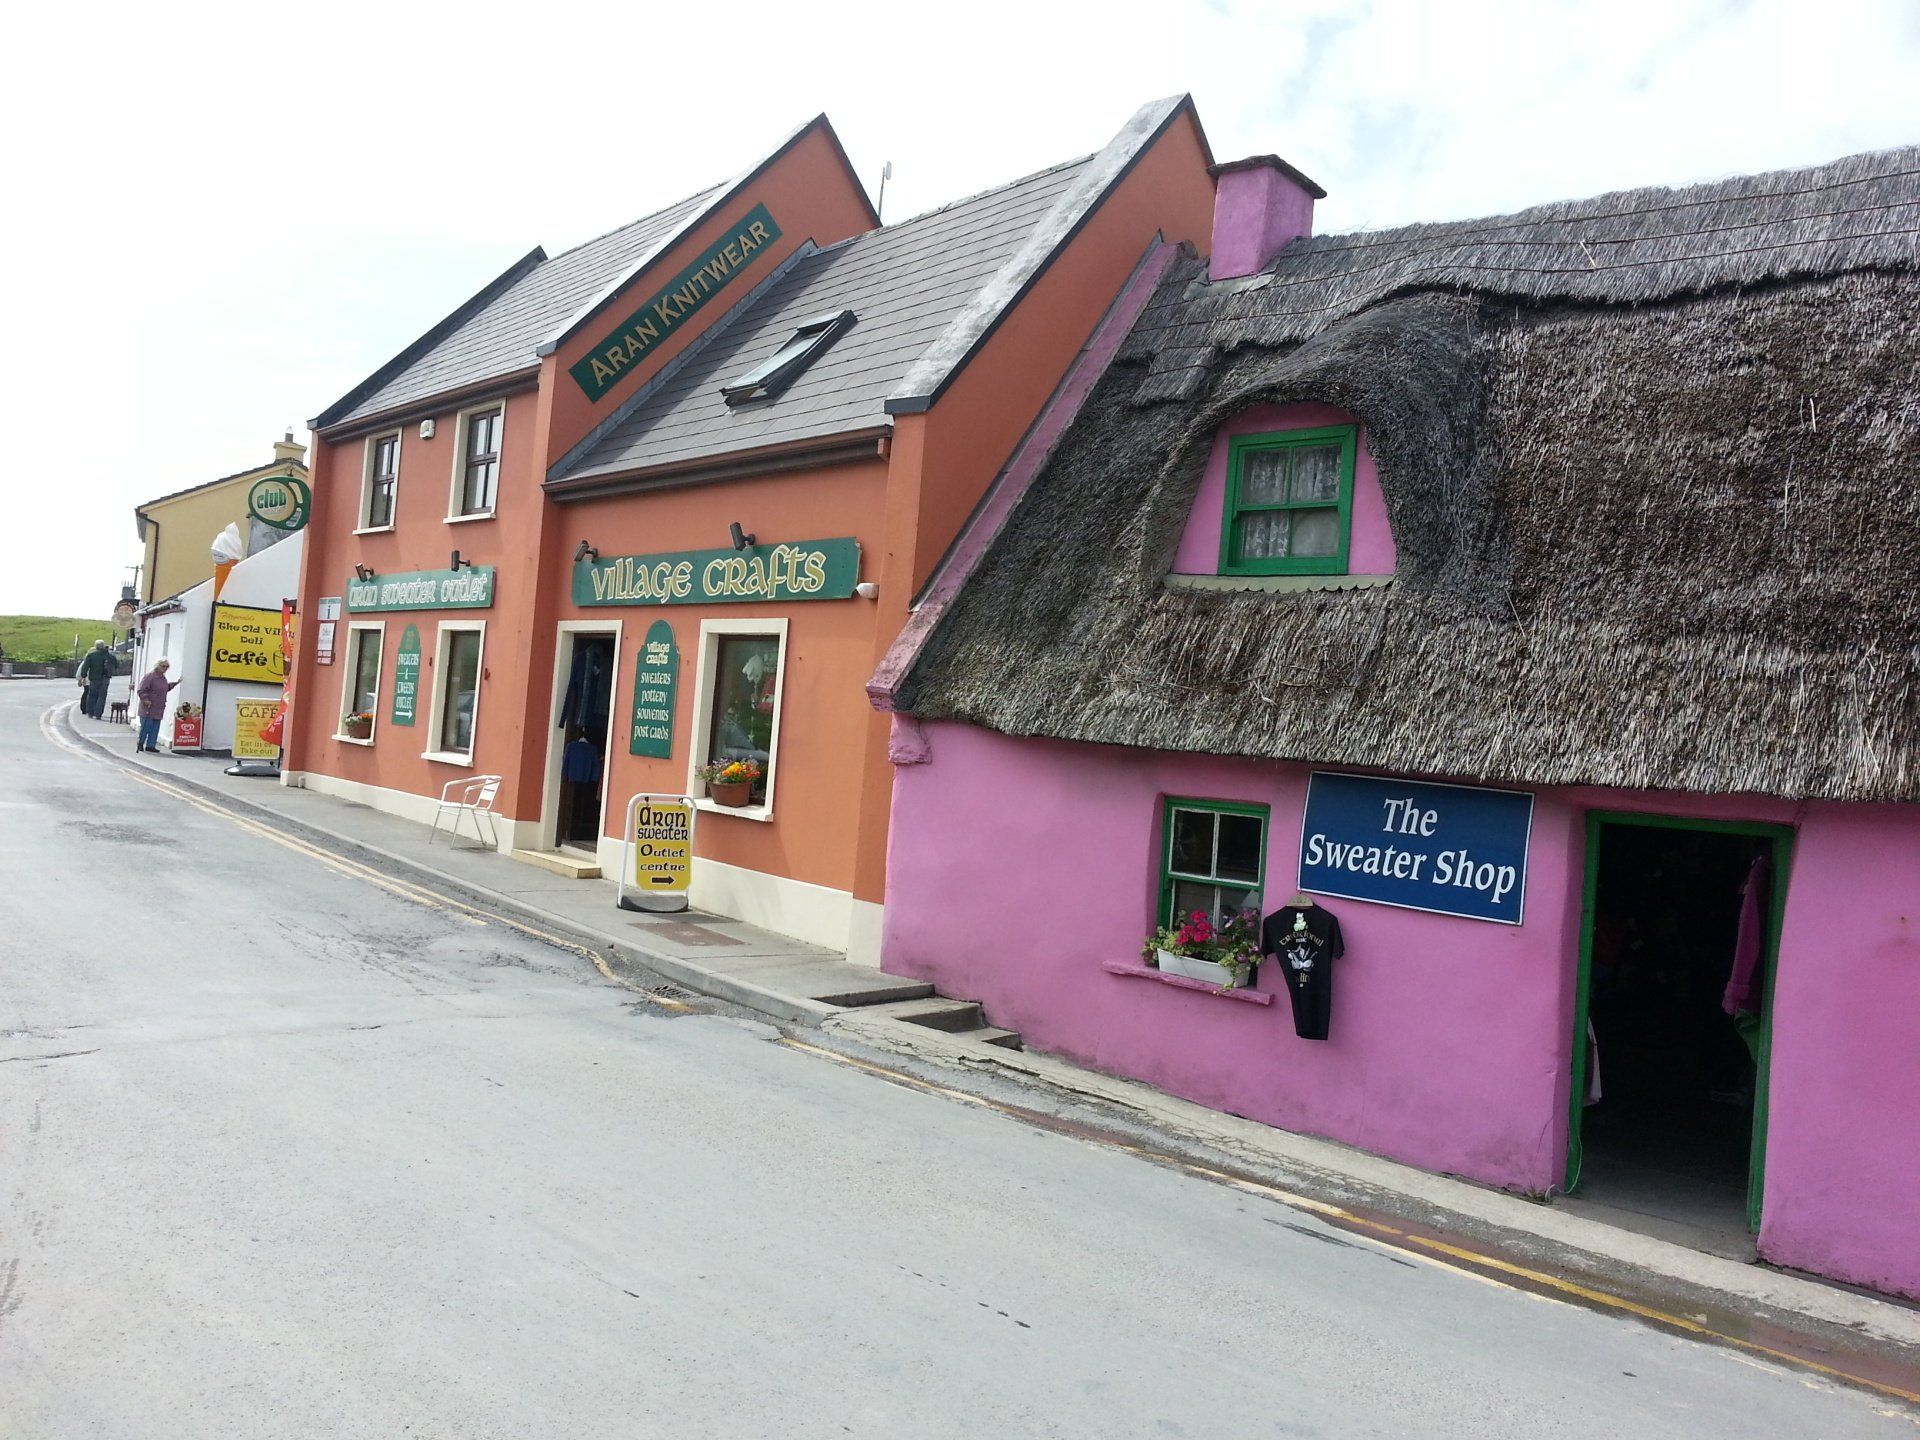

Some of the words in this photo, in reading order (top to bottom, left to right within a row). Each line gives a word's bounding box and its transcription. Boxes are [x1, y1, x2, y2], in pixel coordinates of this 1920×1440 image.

[590, 317, 660, 388] ARAN
[653, 220, 770, 328] KNITWEAR
[256, 488, 287, 509] club
[218, 621, 240, 632] The
[241, 625, 261, 633] Old
[215, 648, 268, 667] Café
[240, 704, 279, 719] CAFÉ
[1383, 797, 1438, 837] The
[641, 844, 685, 858] Outlet
[640, 862, 685, 872] centre
[1305, 833, 1427, 881] Sweater
[1432, 849, 1516, 903] Shop
